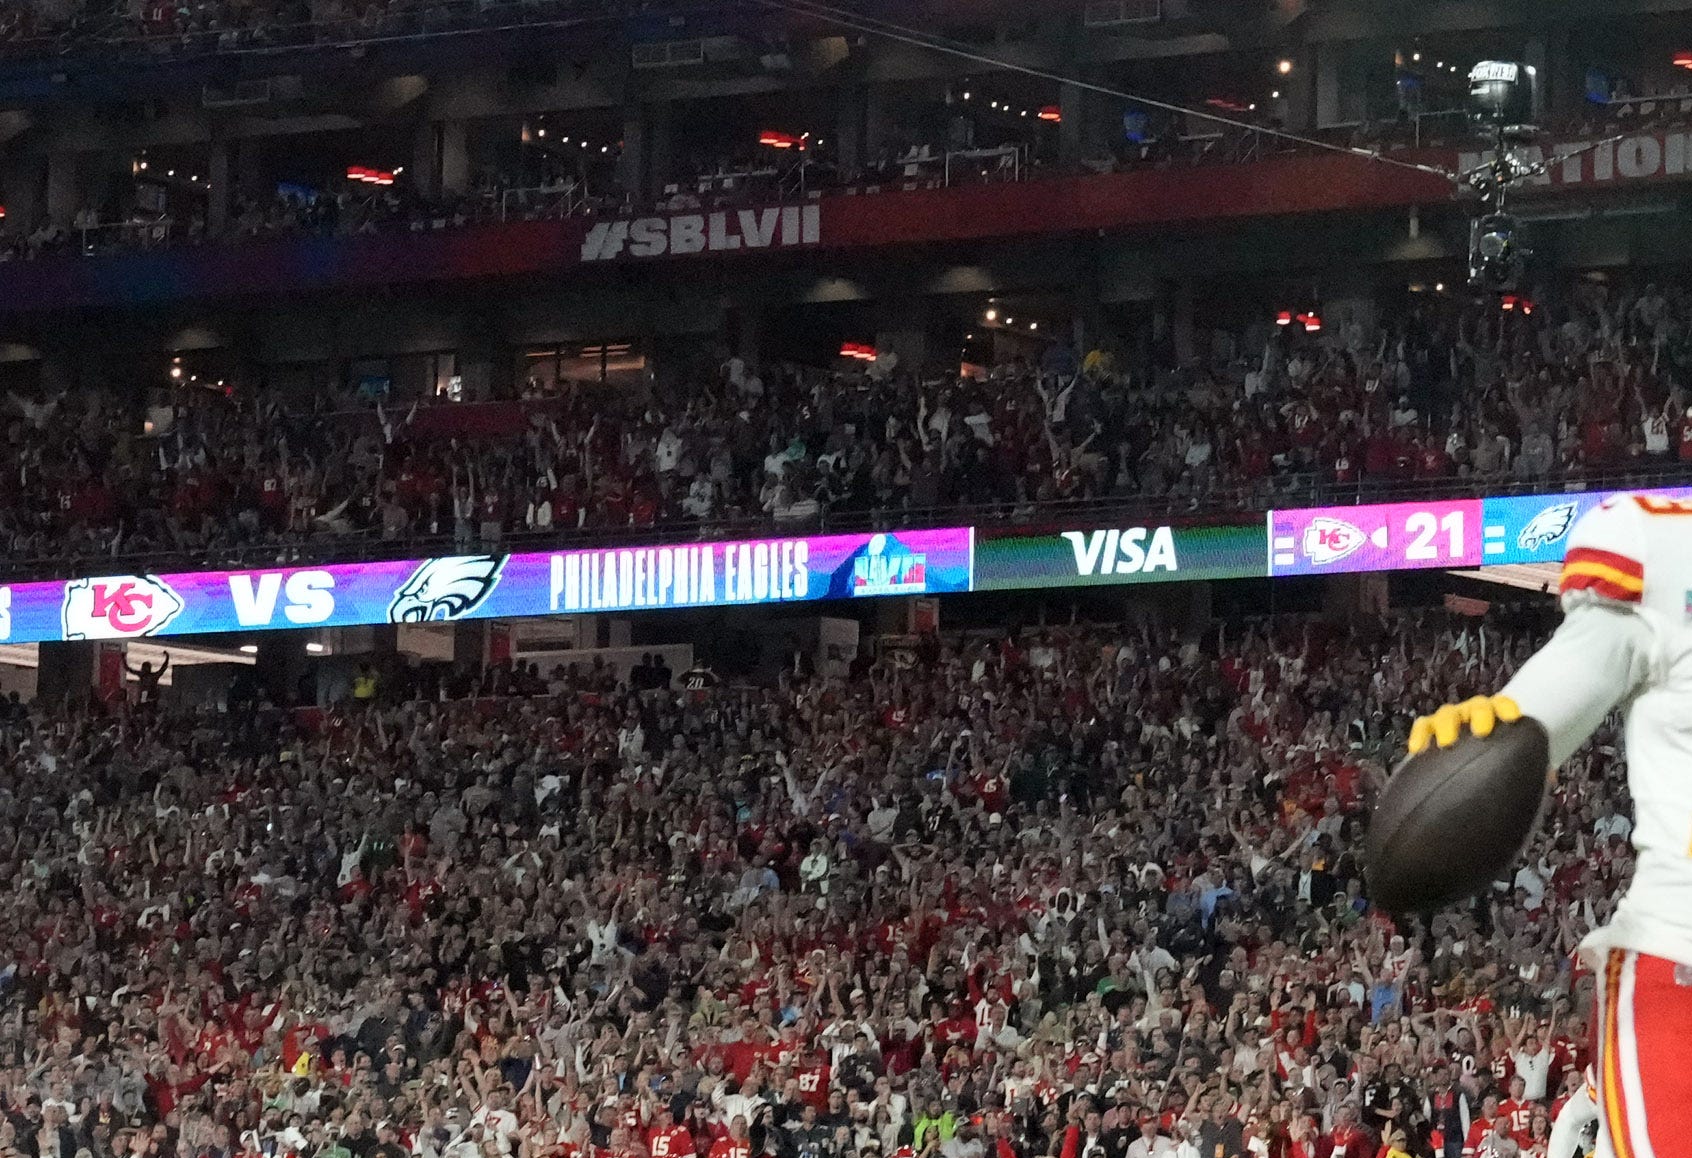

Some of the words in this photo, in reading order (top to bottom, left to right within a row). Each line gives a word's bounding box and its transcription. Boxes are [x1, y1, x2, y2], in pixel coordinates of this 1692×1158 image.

[580, 204, 820, 262] #SBLVII
[1061, 526, 1178, 576] VISA
[1405, 511, 1464, 560] 21
[228, 570, 334, 626] VS
[550, 544, 716, 611] PHILADELPHIA
[724, 540, 809, 600] EAGLES
[799, 1073, 821, 1092] 87
[1490, 1060, 1507, 1079] 15
[1509, 1109, 1530, 1132] 15
[652, 1136, 671, 1157] 15
